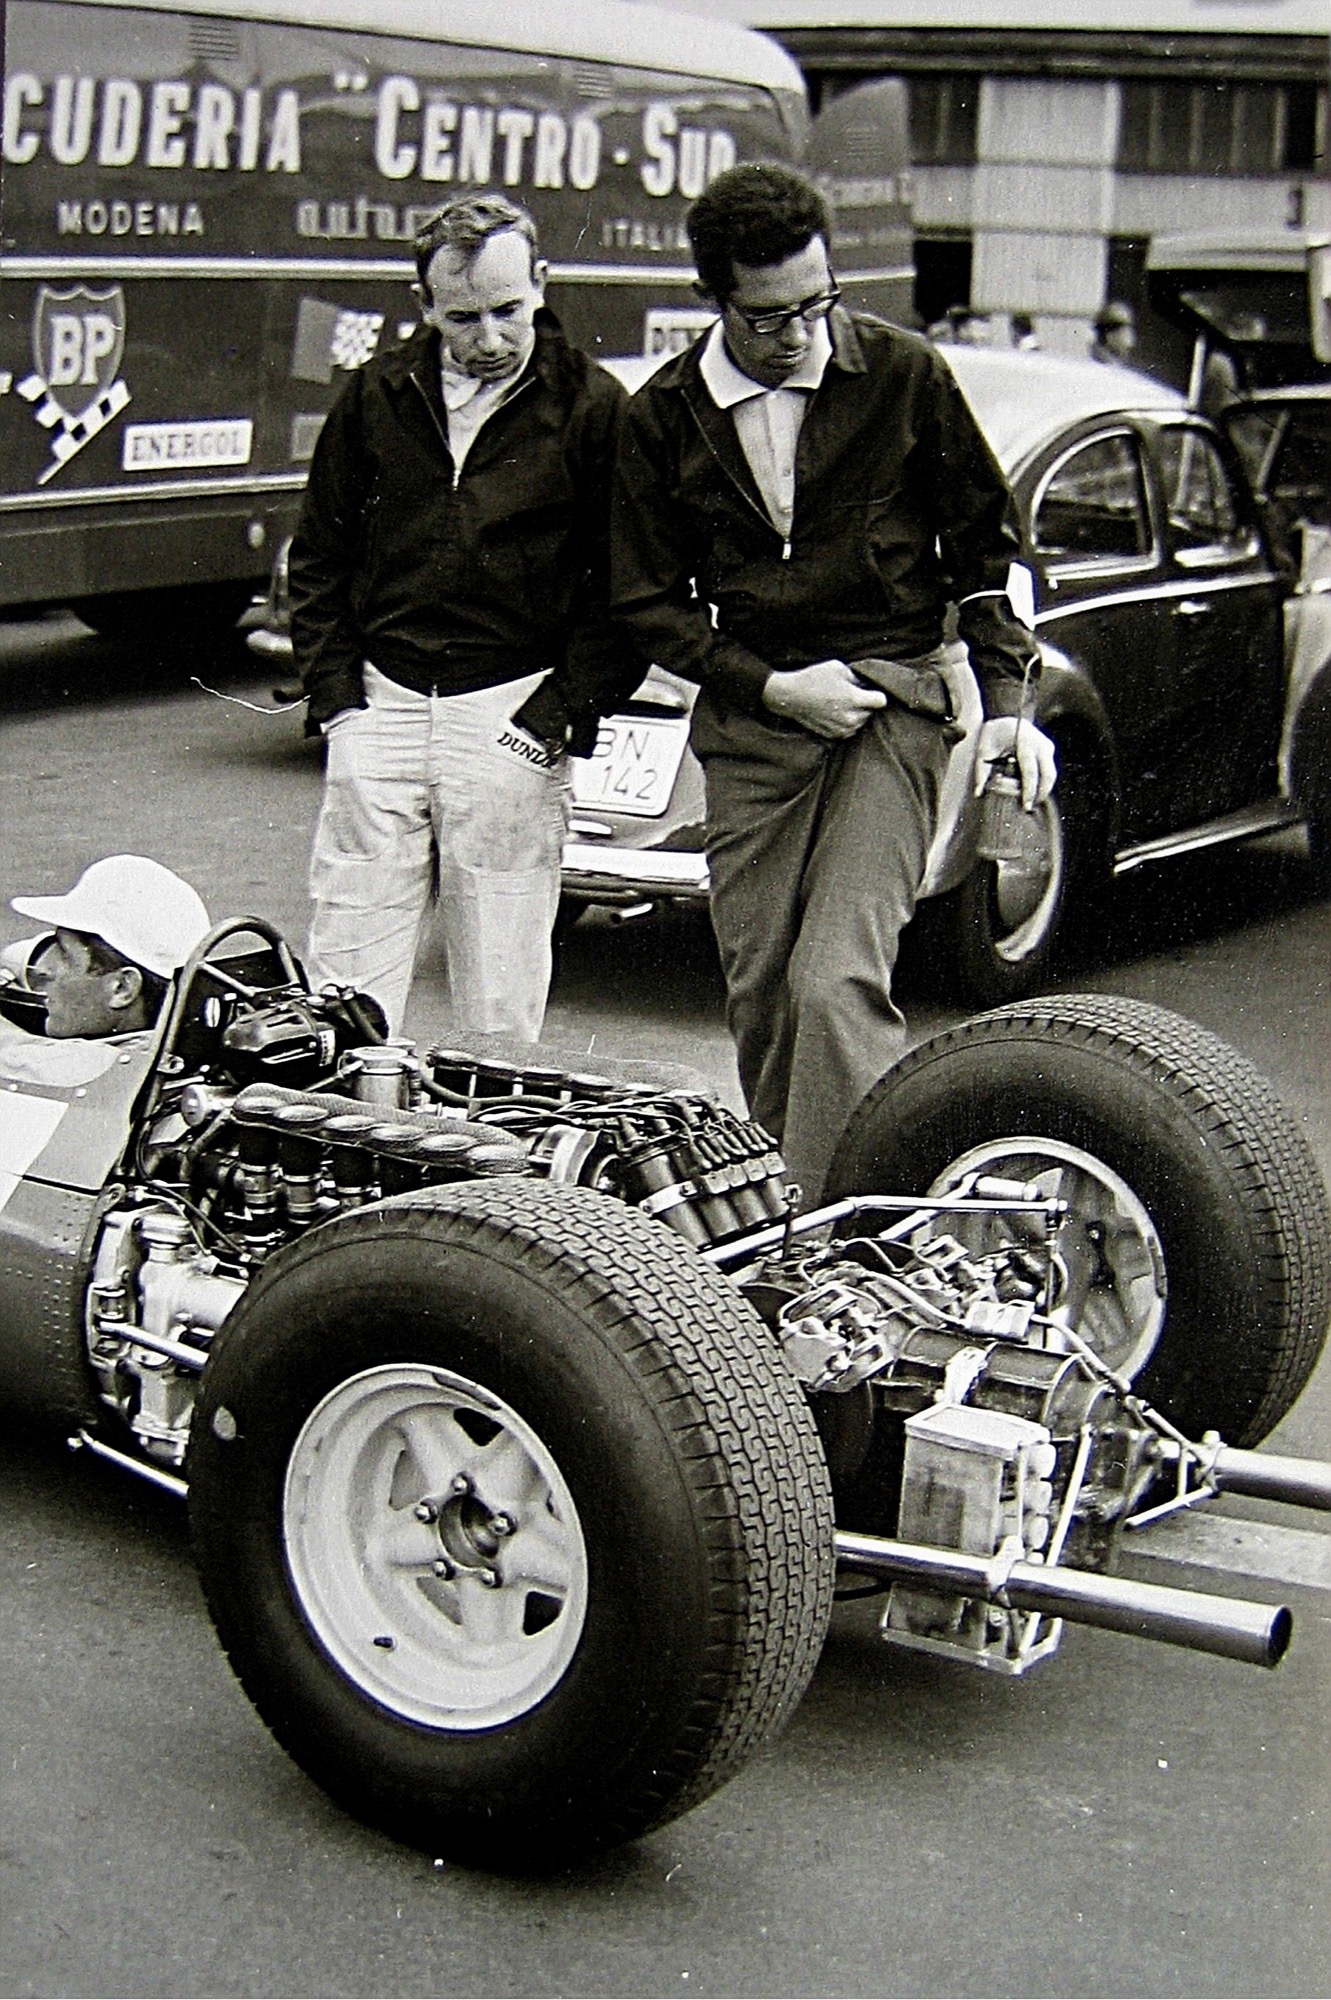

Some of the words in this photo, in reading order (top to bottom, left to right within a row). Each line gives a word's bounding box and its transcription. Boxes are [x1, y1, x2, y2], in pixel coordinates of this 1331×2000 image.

[57, 200, 204, 235] MODENA
[49, 314, 116, 386] BP
[132, 431, 243, 462] ENERGOL
[497, 731, 560, 769] DUNL
[601, 764, 658, 800] 142
